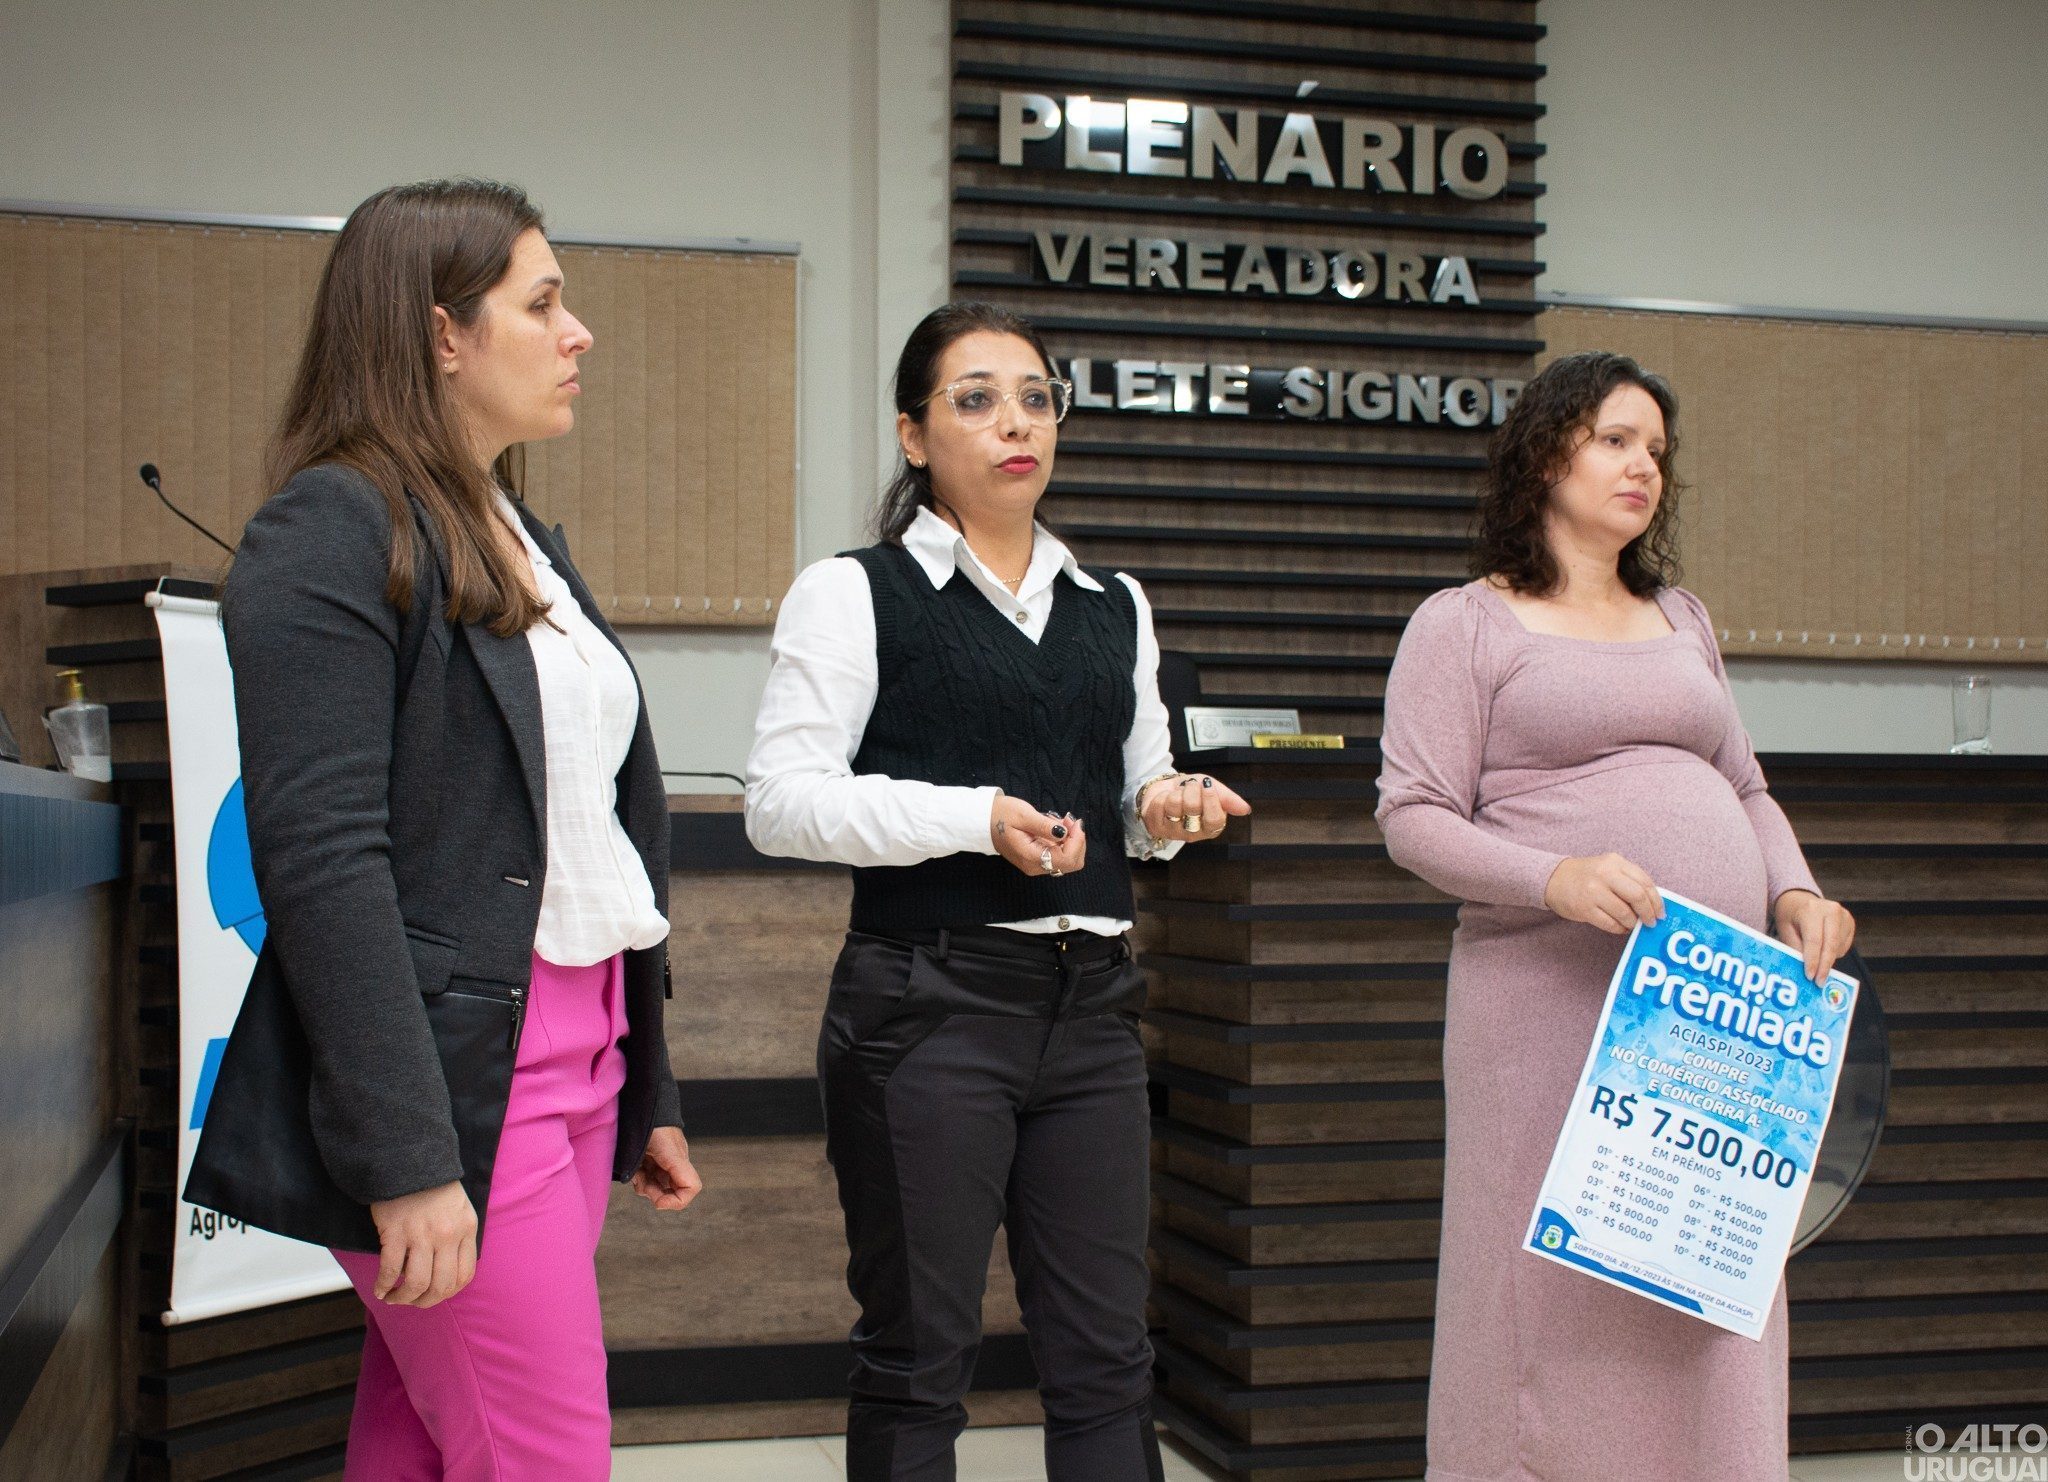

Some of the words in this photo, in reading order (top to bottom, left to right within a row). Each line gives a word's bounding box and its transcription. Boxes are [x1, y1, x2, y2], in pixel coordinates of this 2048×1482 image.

[999, 81, 1509, 200] PLENÁRIO
[1035, 231, 1480, 304] VEREADORA
[1269, 739, 1327, 748] PRESIDENTE
[1666, 929, 1798, 1007] Compra
[1631, 955, 1833, 1066] Premiada
[1669, 1024, 1733, 1056] ACIASPI
[1735, 1048, 1773, 1072] 2023
[1683, 1051, 1750, 1084] COMPRE
[1610, 1045, 1636, 1064] NO
[1637, 1054, 1719, 1093] COMÉRCIO
[1720, 1084, 1808, 1124] ASSOCIADO
[1647, 1077, 1660, 1092] E
[1660, 1083, 1745, 1122] CONCORRA
[1745, 1113, 1762, 1128] A:
[1590, 1085, 1638, 1129] R$
[1651, 1107, 1796, 1188] 7.500,00
[1622, 1155, 1634, 1167] R$
[1637, 1161, 1680, 1185] 2.000,00
[1651, 1147, 1669, 1160] EM
[1672, 1154, 1722, 1181] PRÊMIOS
[1613, 1186, 1626, 1197] R$
[1629, 1192, 1669, 1215] 1.000,00
[1618, 1171, 1631, 1182] R$
[1634, 1177, 1674, 1199] 1.500,00
[1608, 1201, 1621, 1213] R$
[1624, 1207, 1659, 1227] 800,00
[1714, 1209, 1727, 1221] R$
[1729, 1216, 1763, 1236] 400,00
[1720, 1195, 1732, 1207] R$
[1734, 1201, 1767, 1220] 500,00
[1602, 1216, 1615, 1228] R$
[1618, 1222, 1652, 1242] 600,00
[1710, 1225, 1723, 1237] R$
[1725, 1231, 1758, 1251] 300,00
[1698, 1254, 1711, 1266] R$
[1713, 1260, 1747, 1280] 200,00
[1705, 1240, 1718, 1252] R$
[1720, 1246, 1753, 1266] 200,00
[1573, 1242, 1604, 1260] SORTEIO
[1686, 1286, 1697, 1296] NA
[1697, 1291, 1715, 1303] SEDE
[1715, 1298, 1726, 1308] DA
